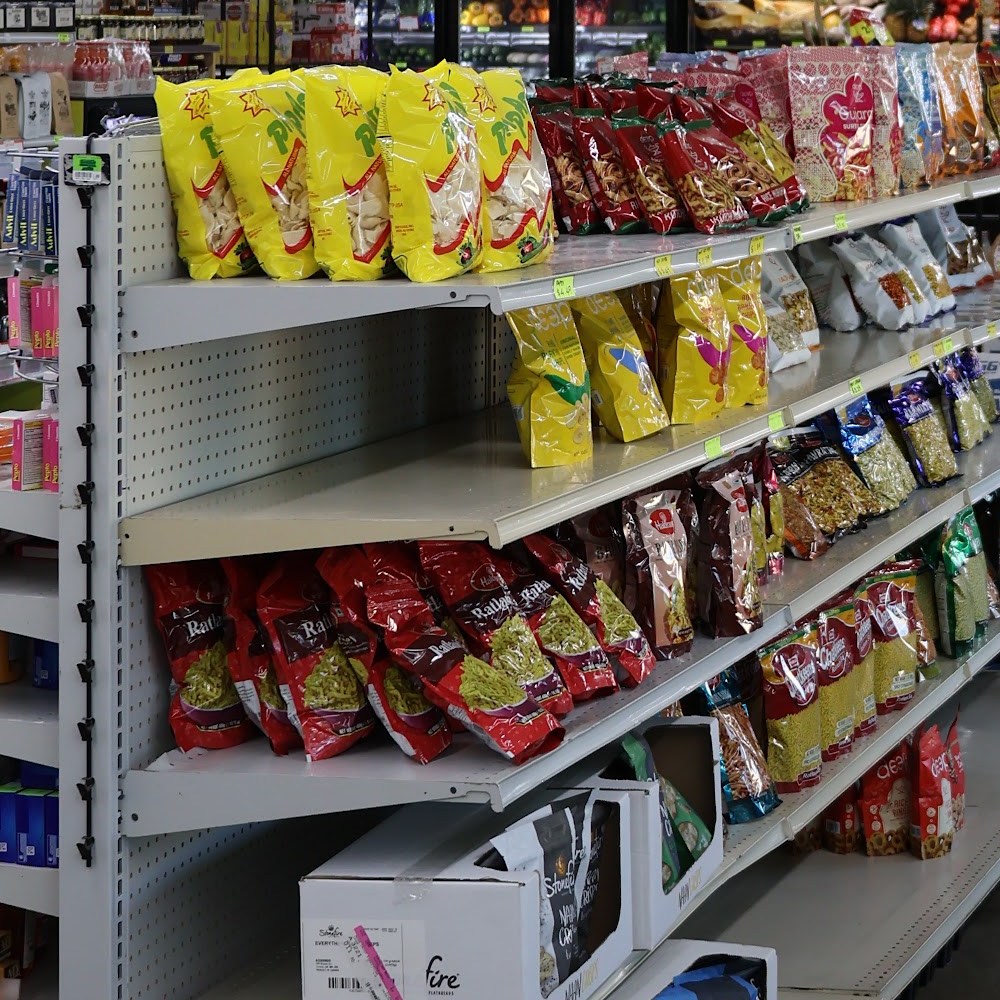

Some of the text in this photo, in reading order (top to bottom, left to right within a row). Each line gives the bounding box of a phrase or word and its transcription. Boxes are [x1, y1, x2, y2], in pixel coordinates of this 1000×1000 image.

[5, 215, 14, 239] Advil
[30, 223, 38, 247] Advil
[45, 228, 53, 252] Advil
[10, 320, 19, 340] Pepto
[44, 329, 52, 349] Pepto
[521, 578, 552, 608] Ratla
[187, 611, 223, 639] Ratla
[302, 611, 334, 639] Ratl
[319, 926, 344, 938] Stonefire
[425, 955, 461, 989] fire
